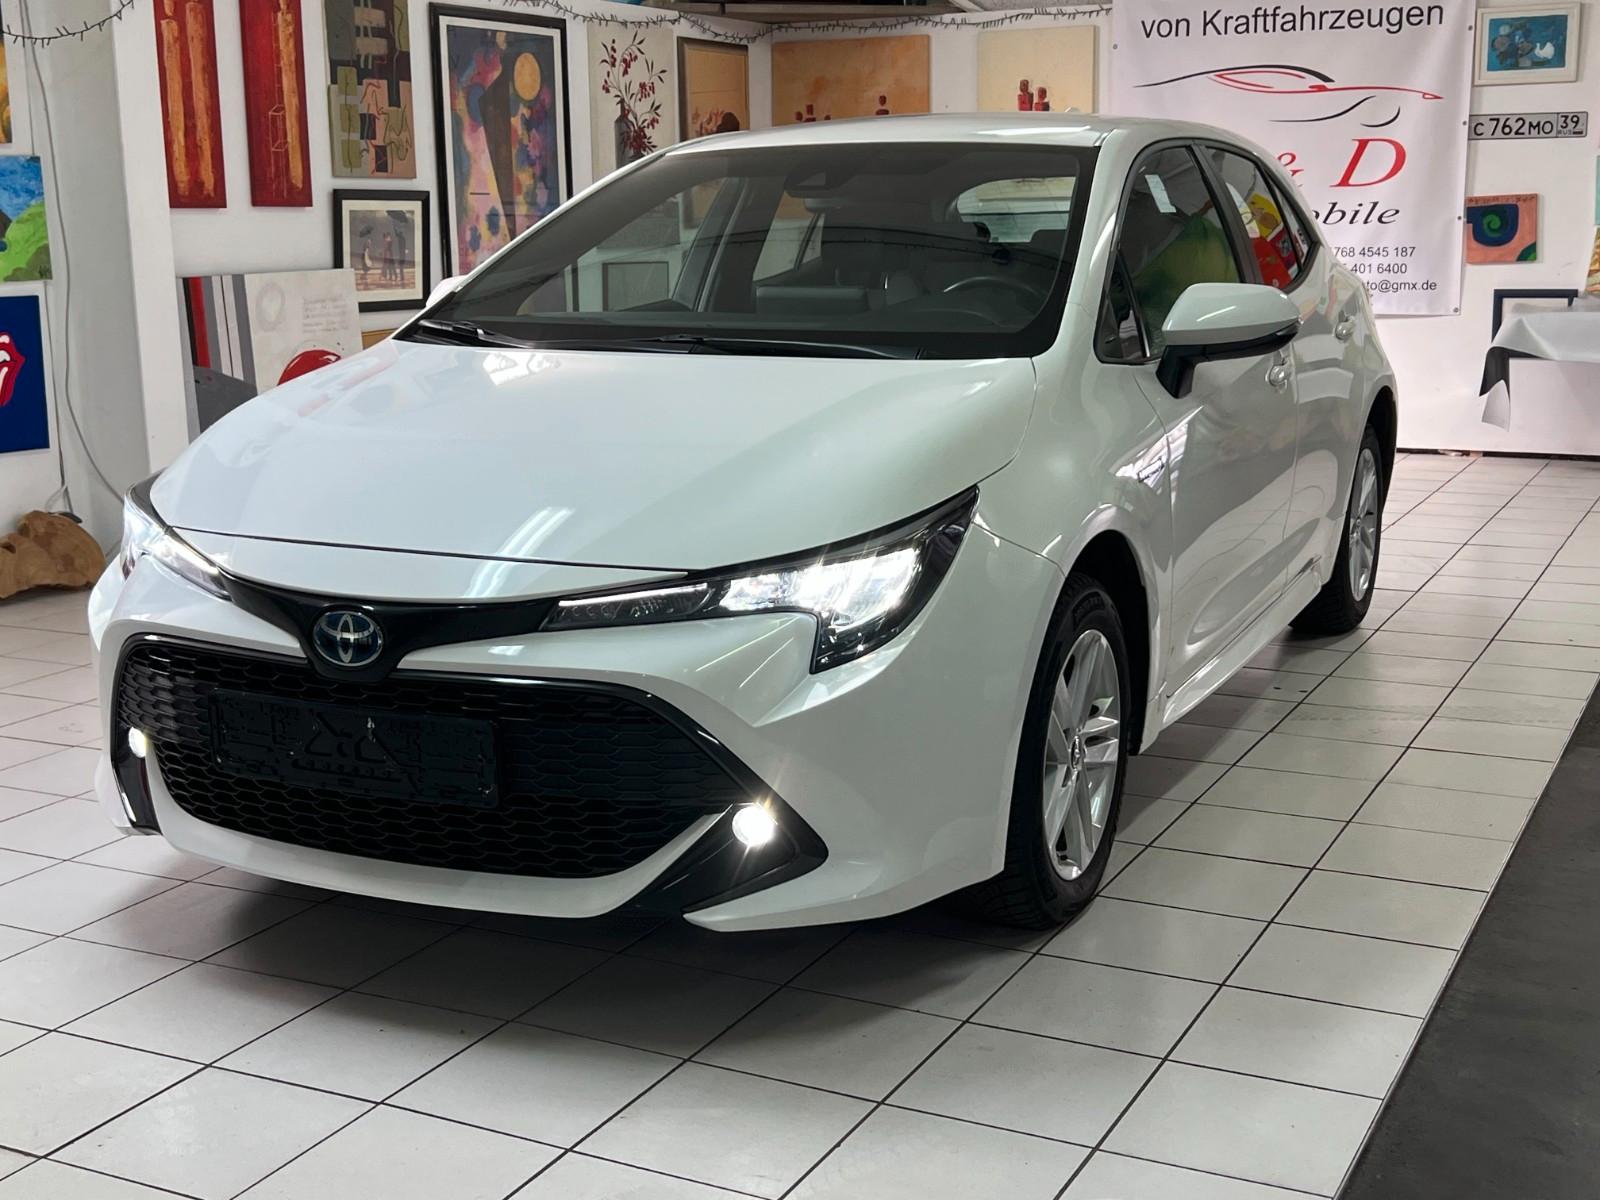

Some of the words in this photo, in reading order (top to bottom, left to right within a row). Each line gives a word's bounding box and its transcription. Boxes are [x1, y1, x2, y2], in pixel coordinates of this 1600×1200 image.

[1140, 17, 1191, 39] von
[1202, 4, 1444, 36] Kraftfahrzeugen
[1560, 115, 1580, 129] 39
[1329, 138, 1407, 188] D
[1358, 246, 1389, 258] 4545
[1394, 246, 1416, 258] 187
[1350, 263, 1372, 274] 401
[1377, 263, 1408, 274] 6400
